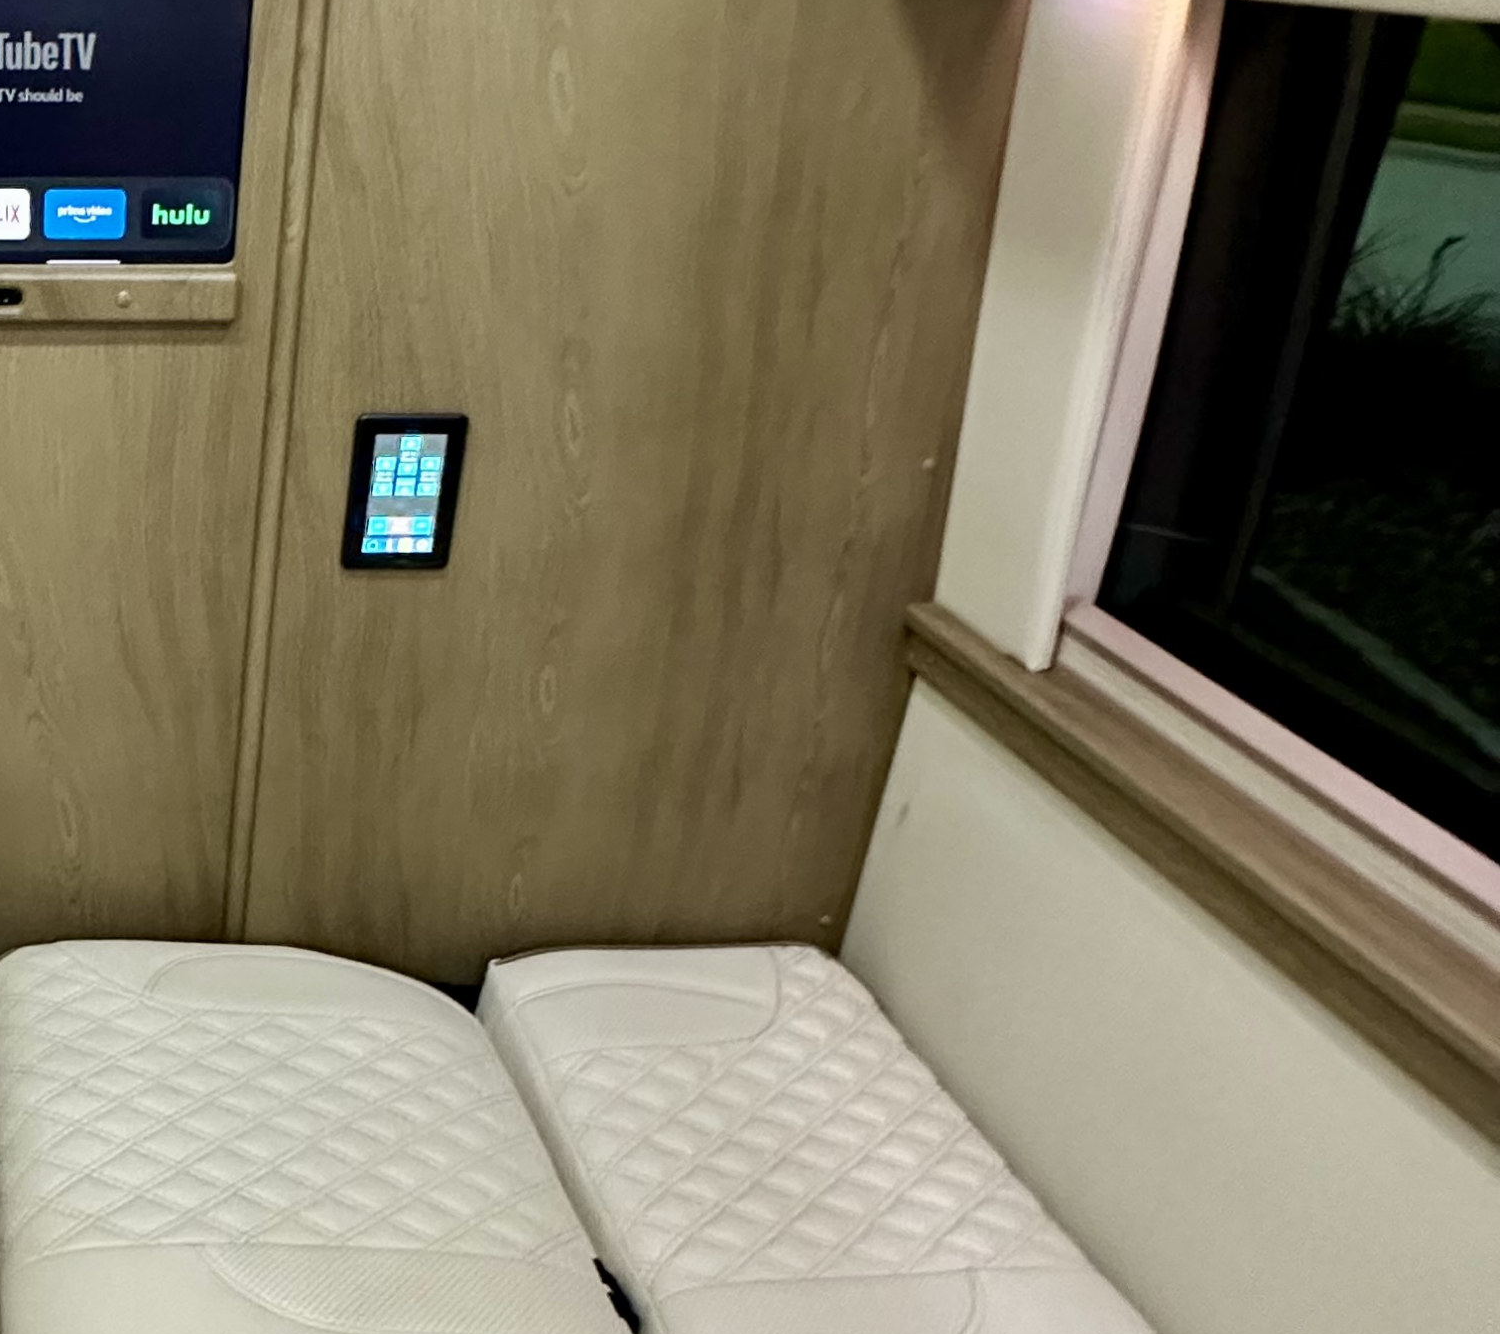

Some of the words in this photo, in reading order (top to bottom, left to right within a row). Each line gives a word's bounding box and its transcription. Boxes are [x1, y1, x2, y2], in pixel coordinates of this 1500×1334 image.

[17, 87, 63, 103] should
[65, 87, 84, 103] be
[151, 203, 210, 225] hulu
